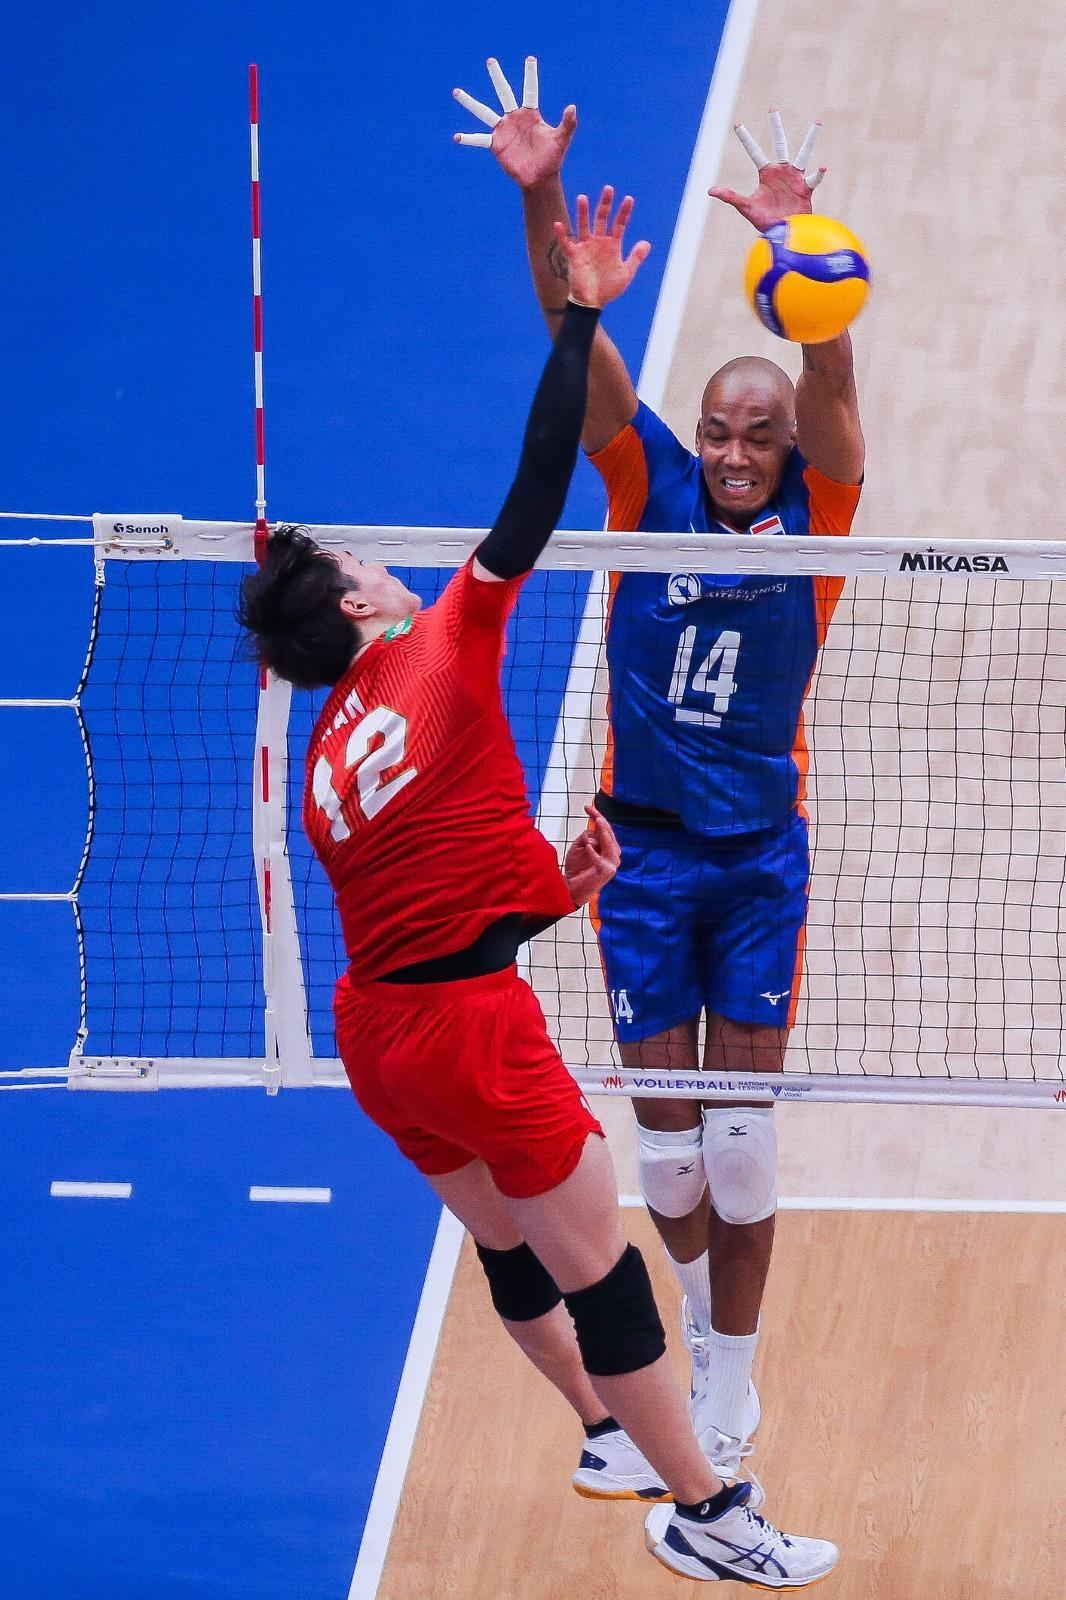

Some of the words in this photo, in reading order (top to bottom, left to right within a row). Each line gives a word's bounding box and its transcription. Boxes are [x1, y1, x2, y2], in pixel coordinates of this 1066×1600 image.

[126, 524, 169, 534] Senoh
[899, 547, 1009, 573] MIKASA
[667, 625, 742, 714] 14
[312, 704, 418, 843] 12
[610, 989, 634, 1025] 14
[601, 1075, 627, 1090] VNL
[632, 1078, 736, 1091] VOLLEYBALL
[1053, 1090, 1066, 1103] VN
